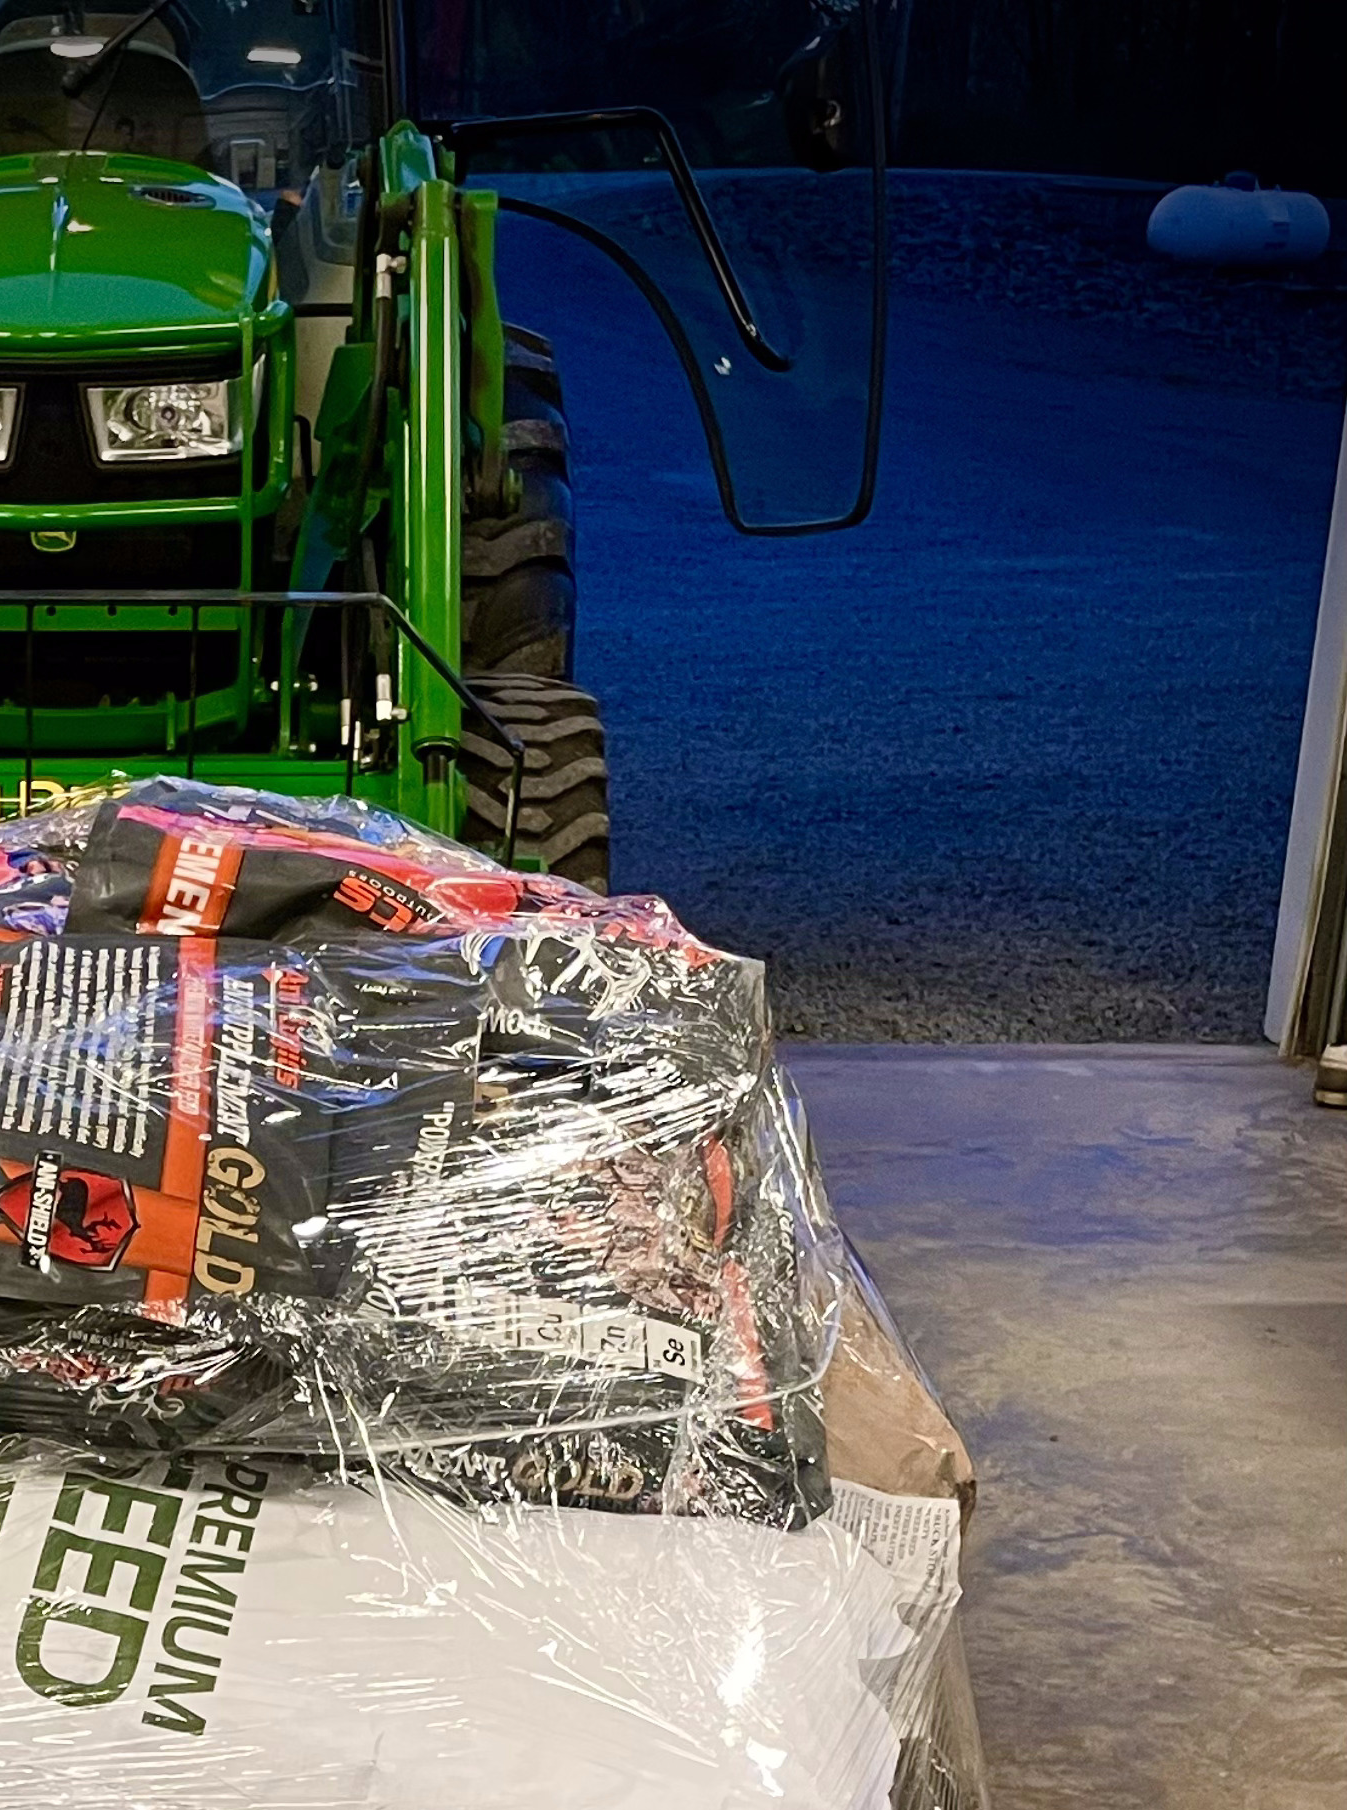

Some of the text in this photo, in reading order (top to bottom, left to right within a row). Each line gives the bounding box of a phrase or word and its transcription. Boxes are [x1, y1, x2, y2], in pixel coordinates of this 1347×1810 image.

[27, 1160, 59, 1247] ANI-SHIELD
[194, 1145, 266, 1296] GOLD
[662, 1338, 686, 1366] Se
[142, 1462, 269, 1736] PREMIUM
